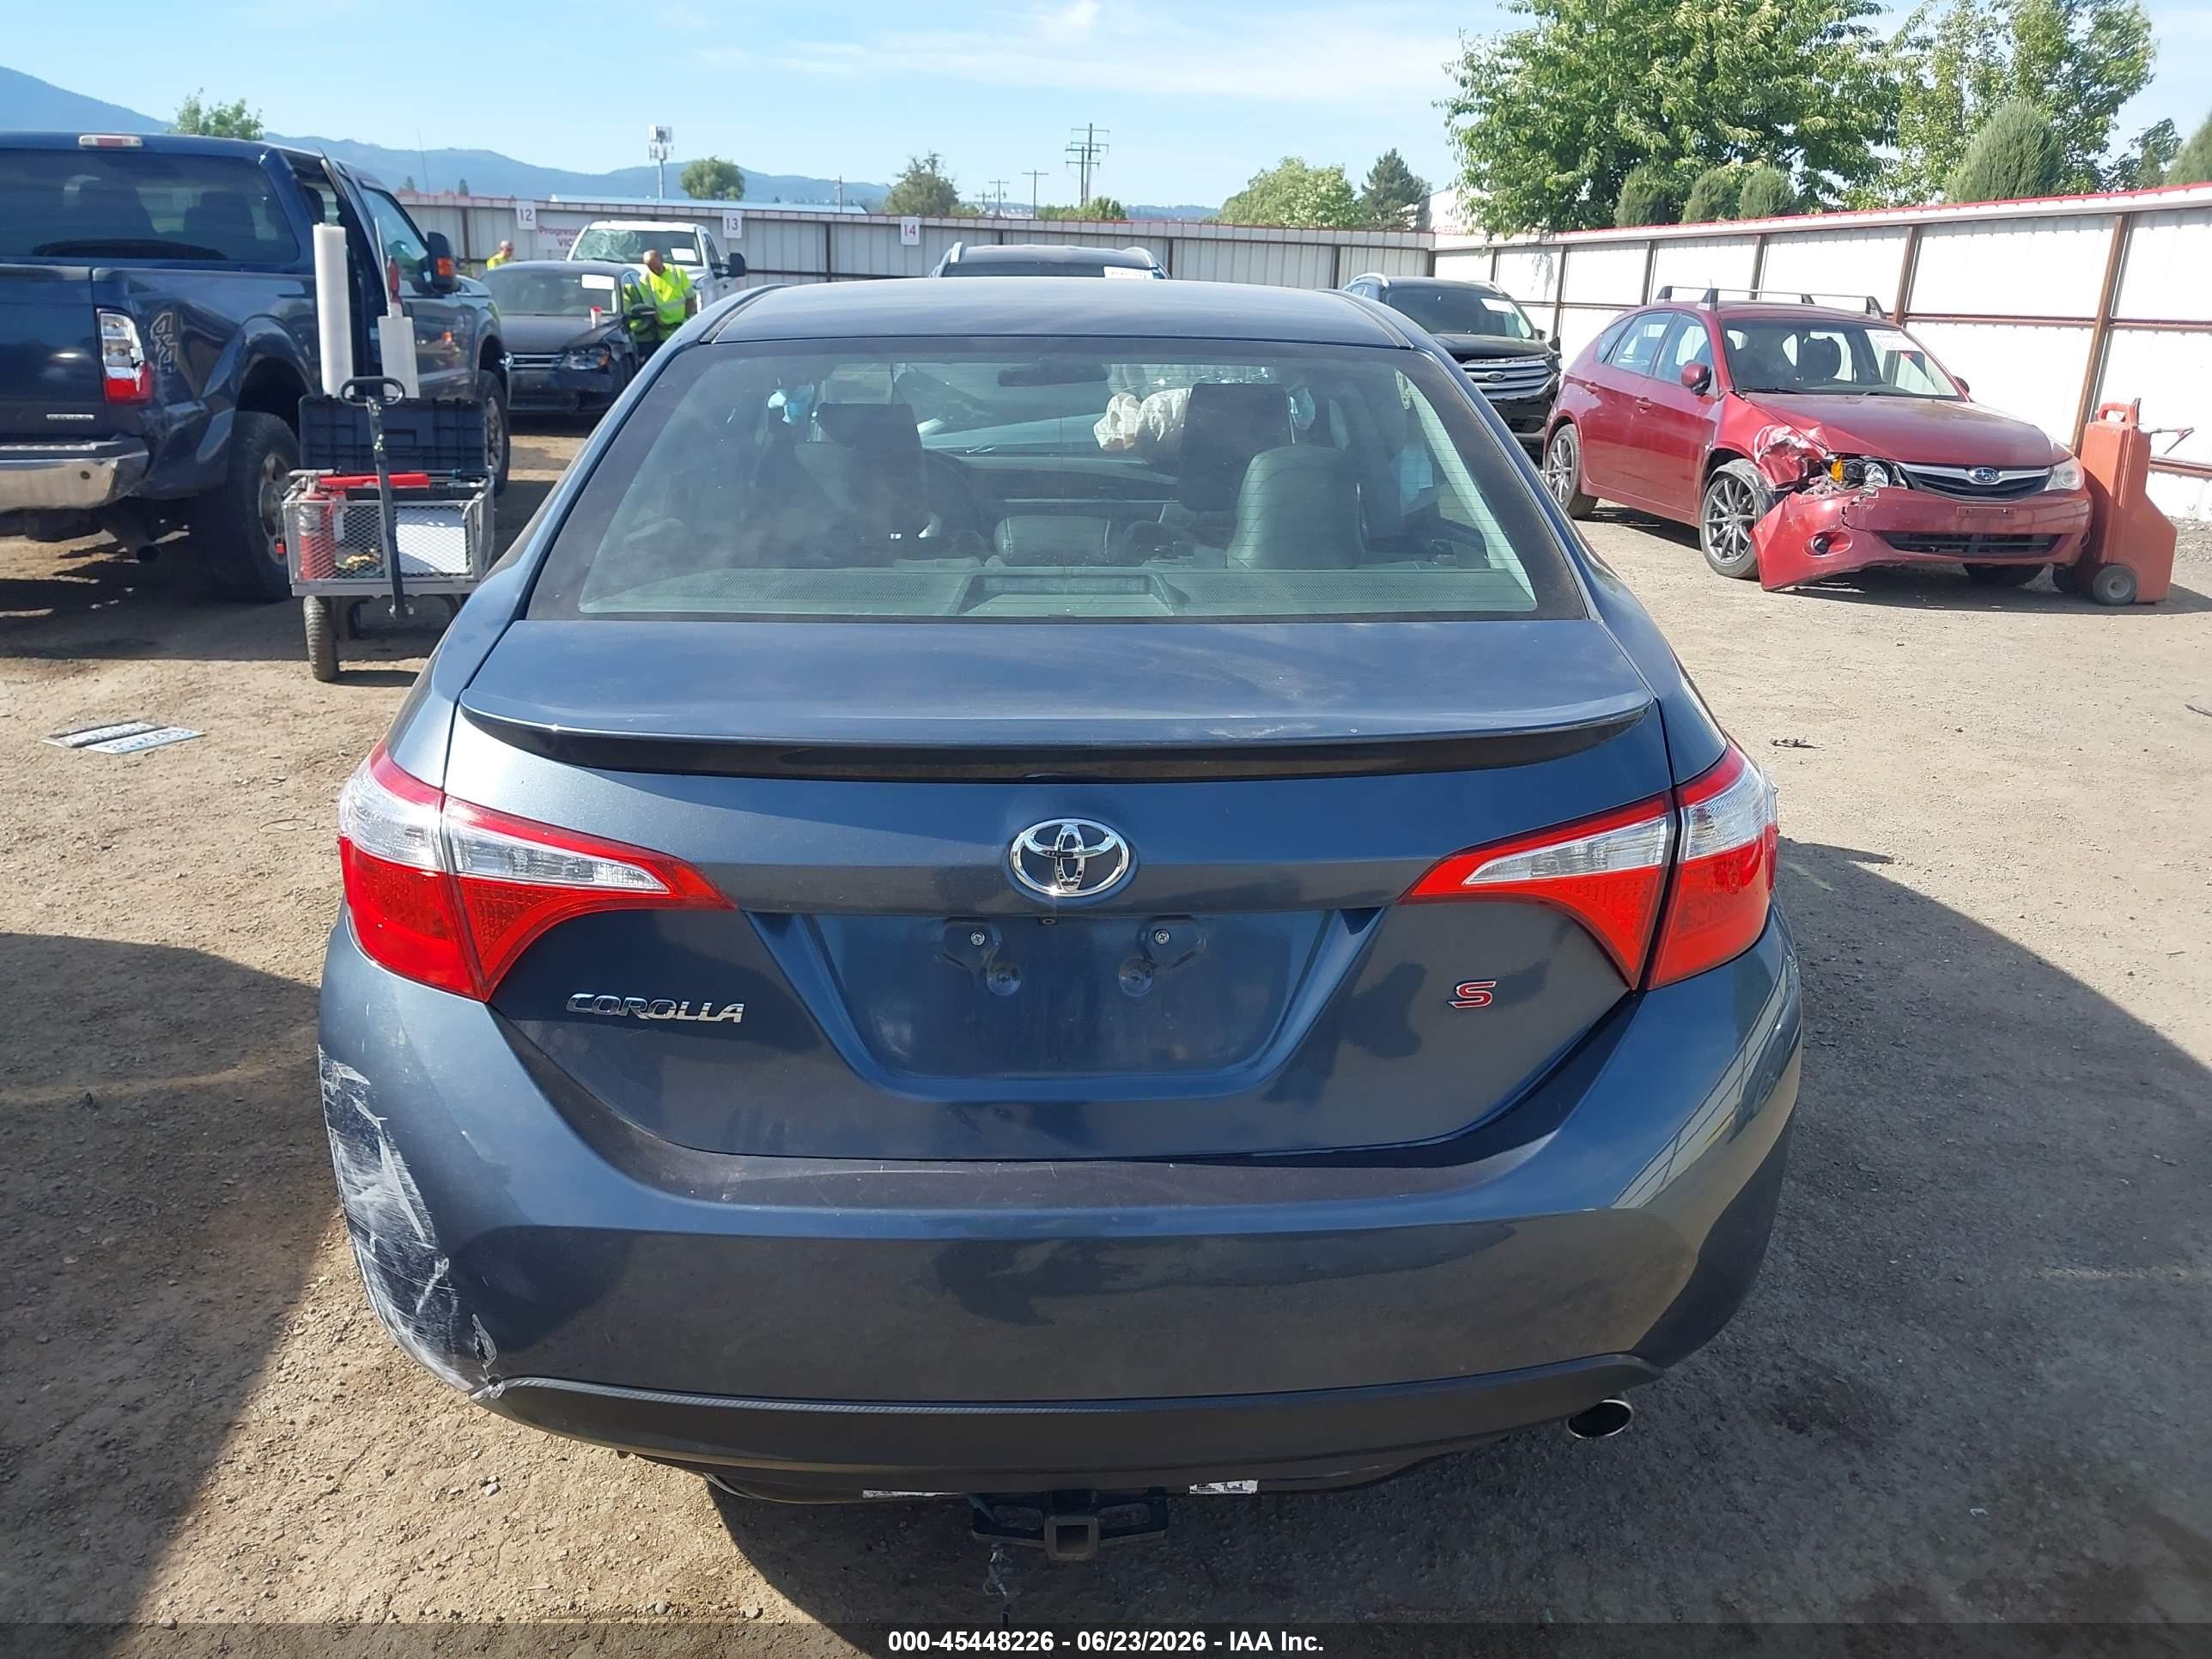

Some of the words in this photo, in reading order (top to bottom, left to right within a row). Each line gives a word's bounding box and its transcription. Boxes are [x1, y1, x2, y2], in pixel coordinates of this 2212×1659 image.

[520, 209, 532, 222] 12
[726, 217, 738, 230] 13
[903, 224, 916, 236] 14
[1447, 981, 1497, 1008] S
[566, 993, 744, 1023] COROLLA
